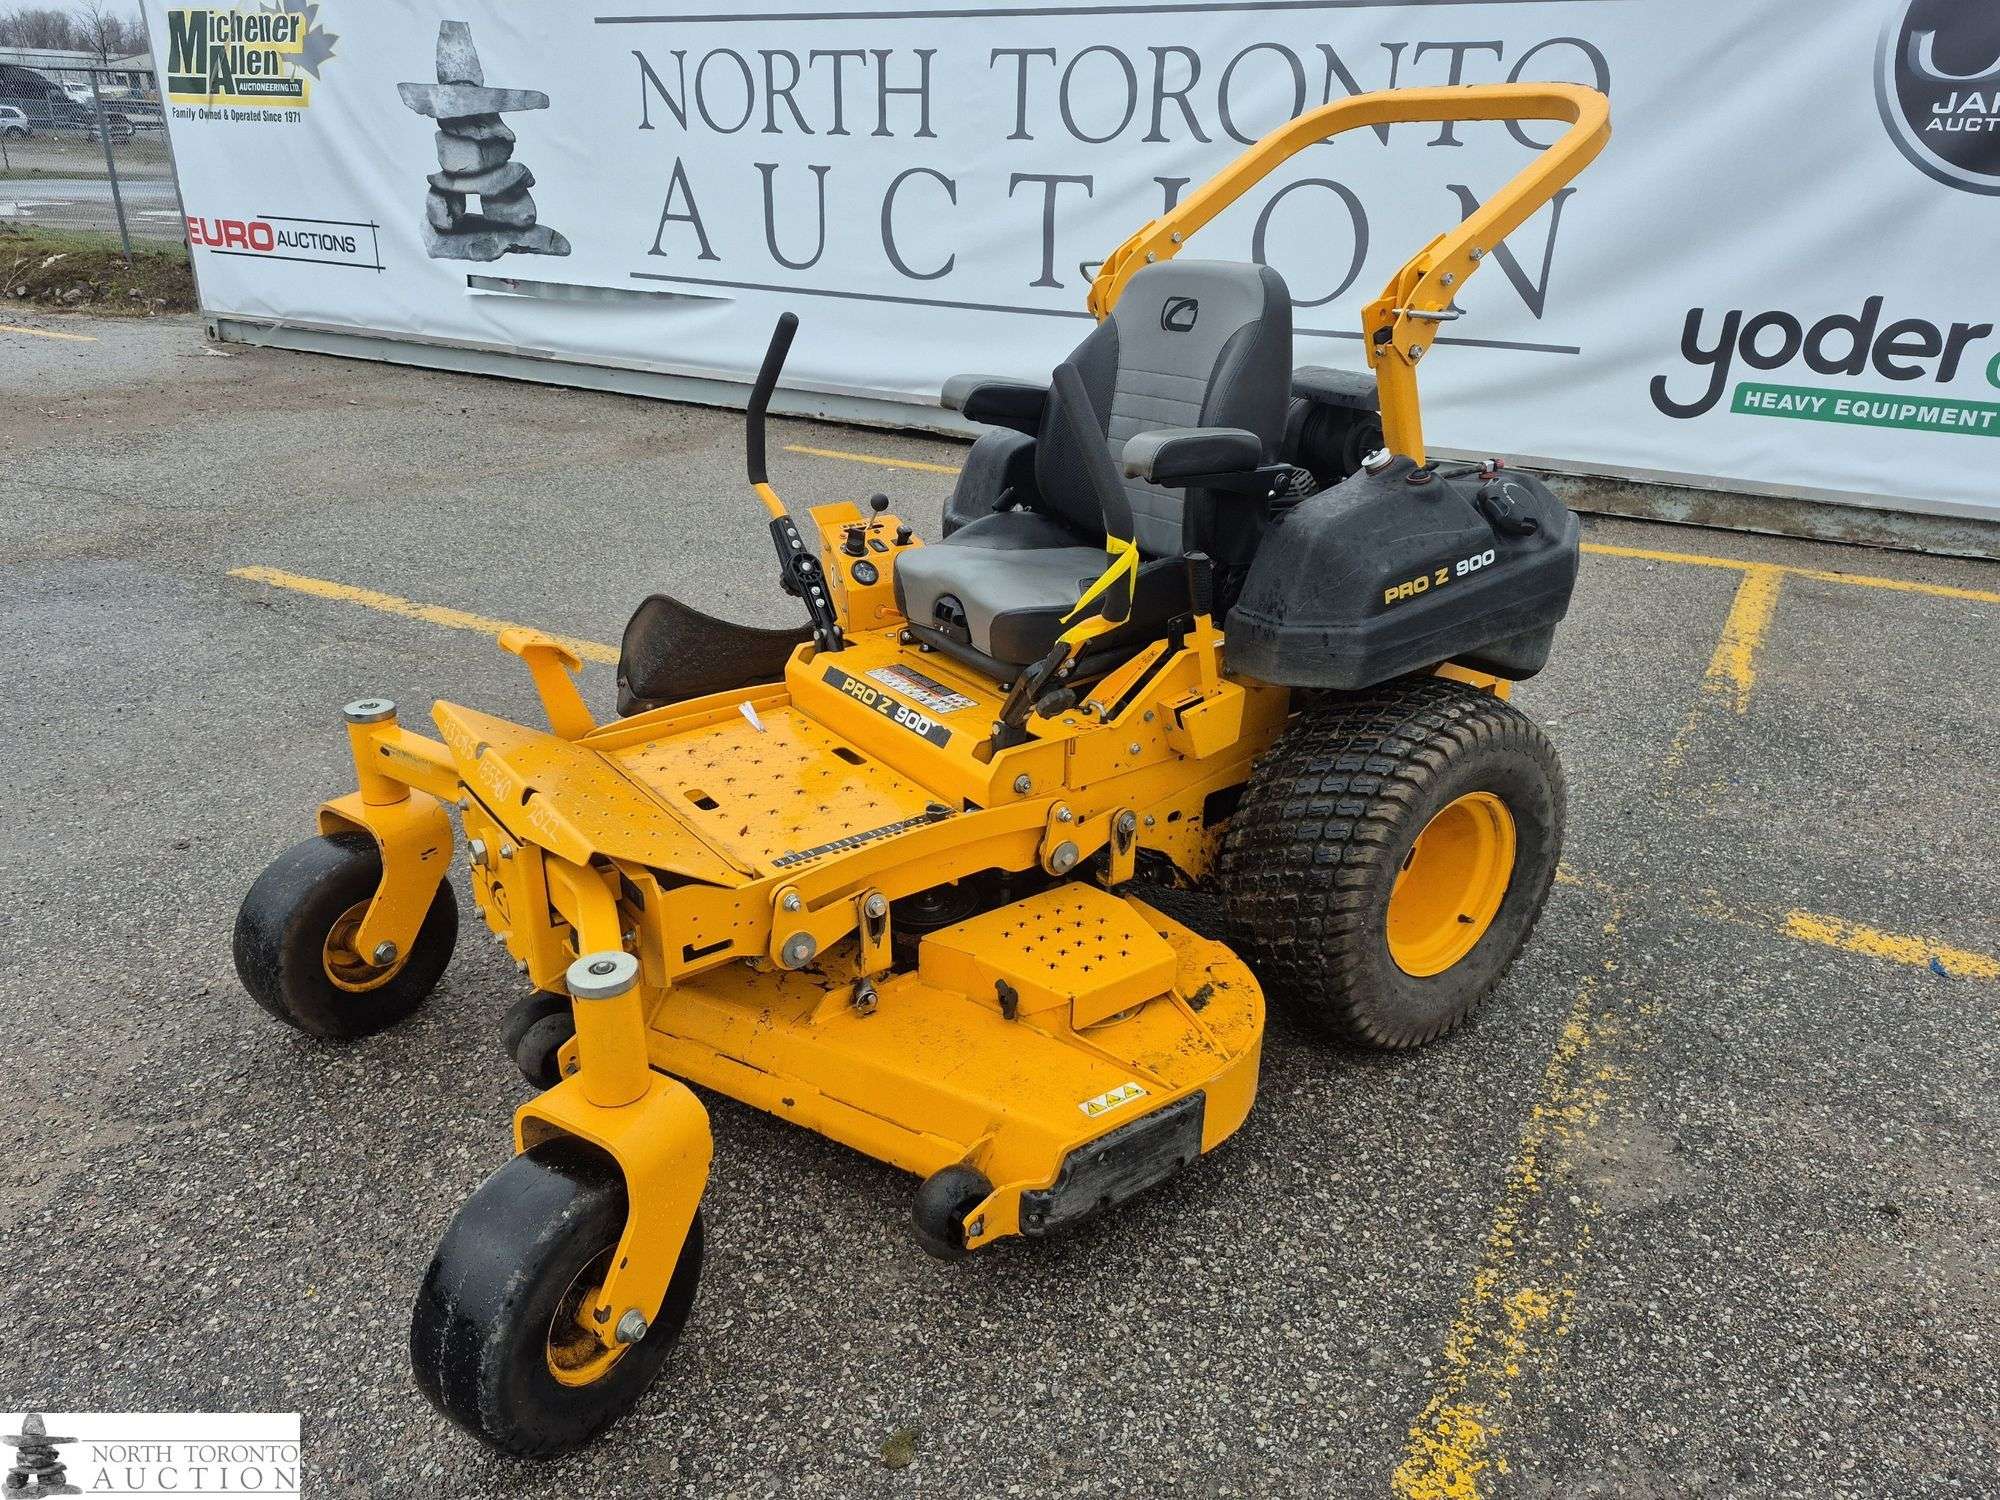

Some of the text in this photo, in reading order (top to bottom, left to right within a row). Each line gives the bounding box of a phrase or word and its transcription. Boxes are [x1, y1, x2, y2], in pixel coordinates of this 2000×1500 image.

[168, 10, 300, 74] Michener
[209, 45, 279, 95] Allen
[239, 82, 289, 93] AUCTIONEERING
[631, 37, 1611, 150] NORTH TORONTO
[172, 107, 301, 123] Family Owned & Operated Since 1971
[186, 216, 356, 254] EURO AUCTIONS
[1650, 295, 1993, 419] yoder
[1744, 390, 1997, 428] HEAVY EQUIPMENT
[1384, 549, 1496, 605] PRO Z 900
[841, 677, 877, 705] PRO
[876, 695, 893, 714] Z
[894, 704, 931, 736] 900
